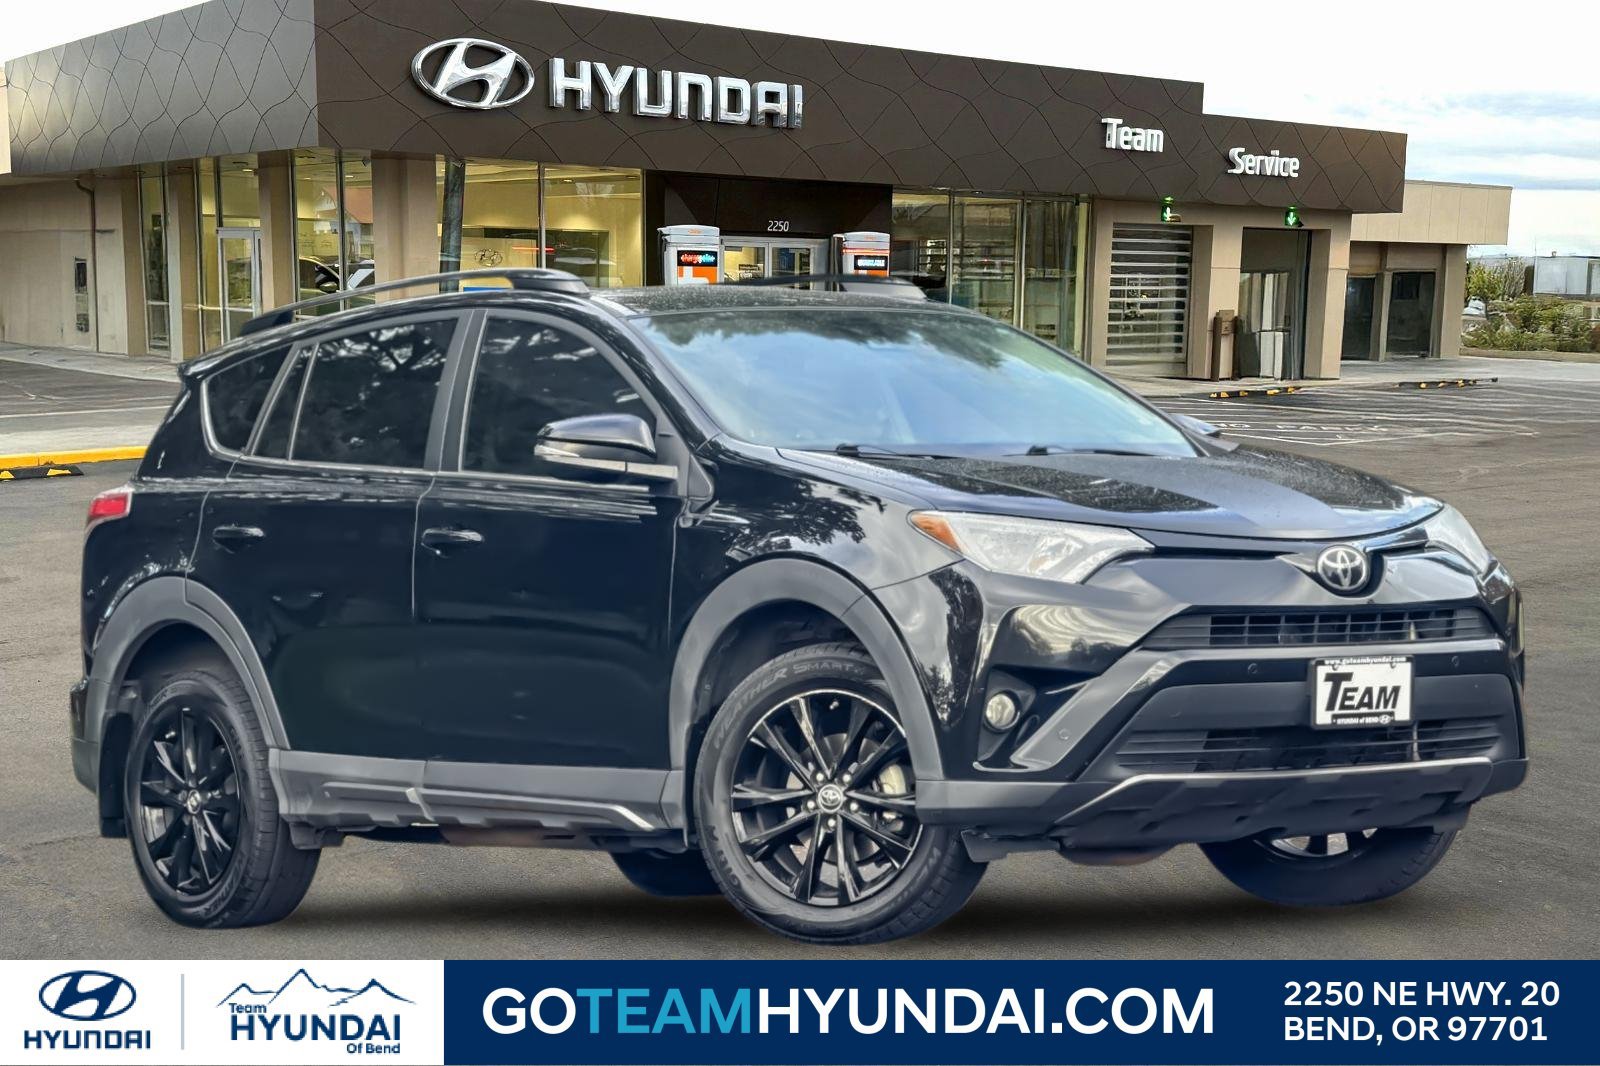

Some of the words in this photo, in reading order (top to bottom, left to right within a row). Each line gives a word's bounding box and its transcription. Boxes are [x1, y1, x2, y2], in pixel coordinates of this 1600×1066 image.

[549, 57, 804, 128] HYUNDAI
[1101, 117, 1164, 153] Team
[1227, 147, 1300, 178] Service
[767, 220, 790, 232] 2250
[1324, 672, 1401, 712] TEAM
